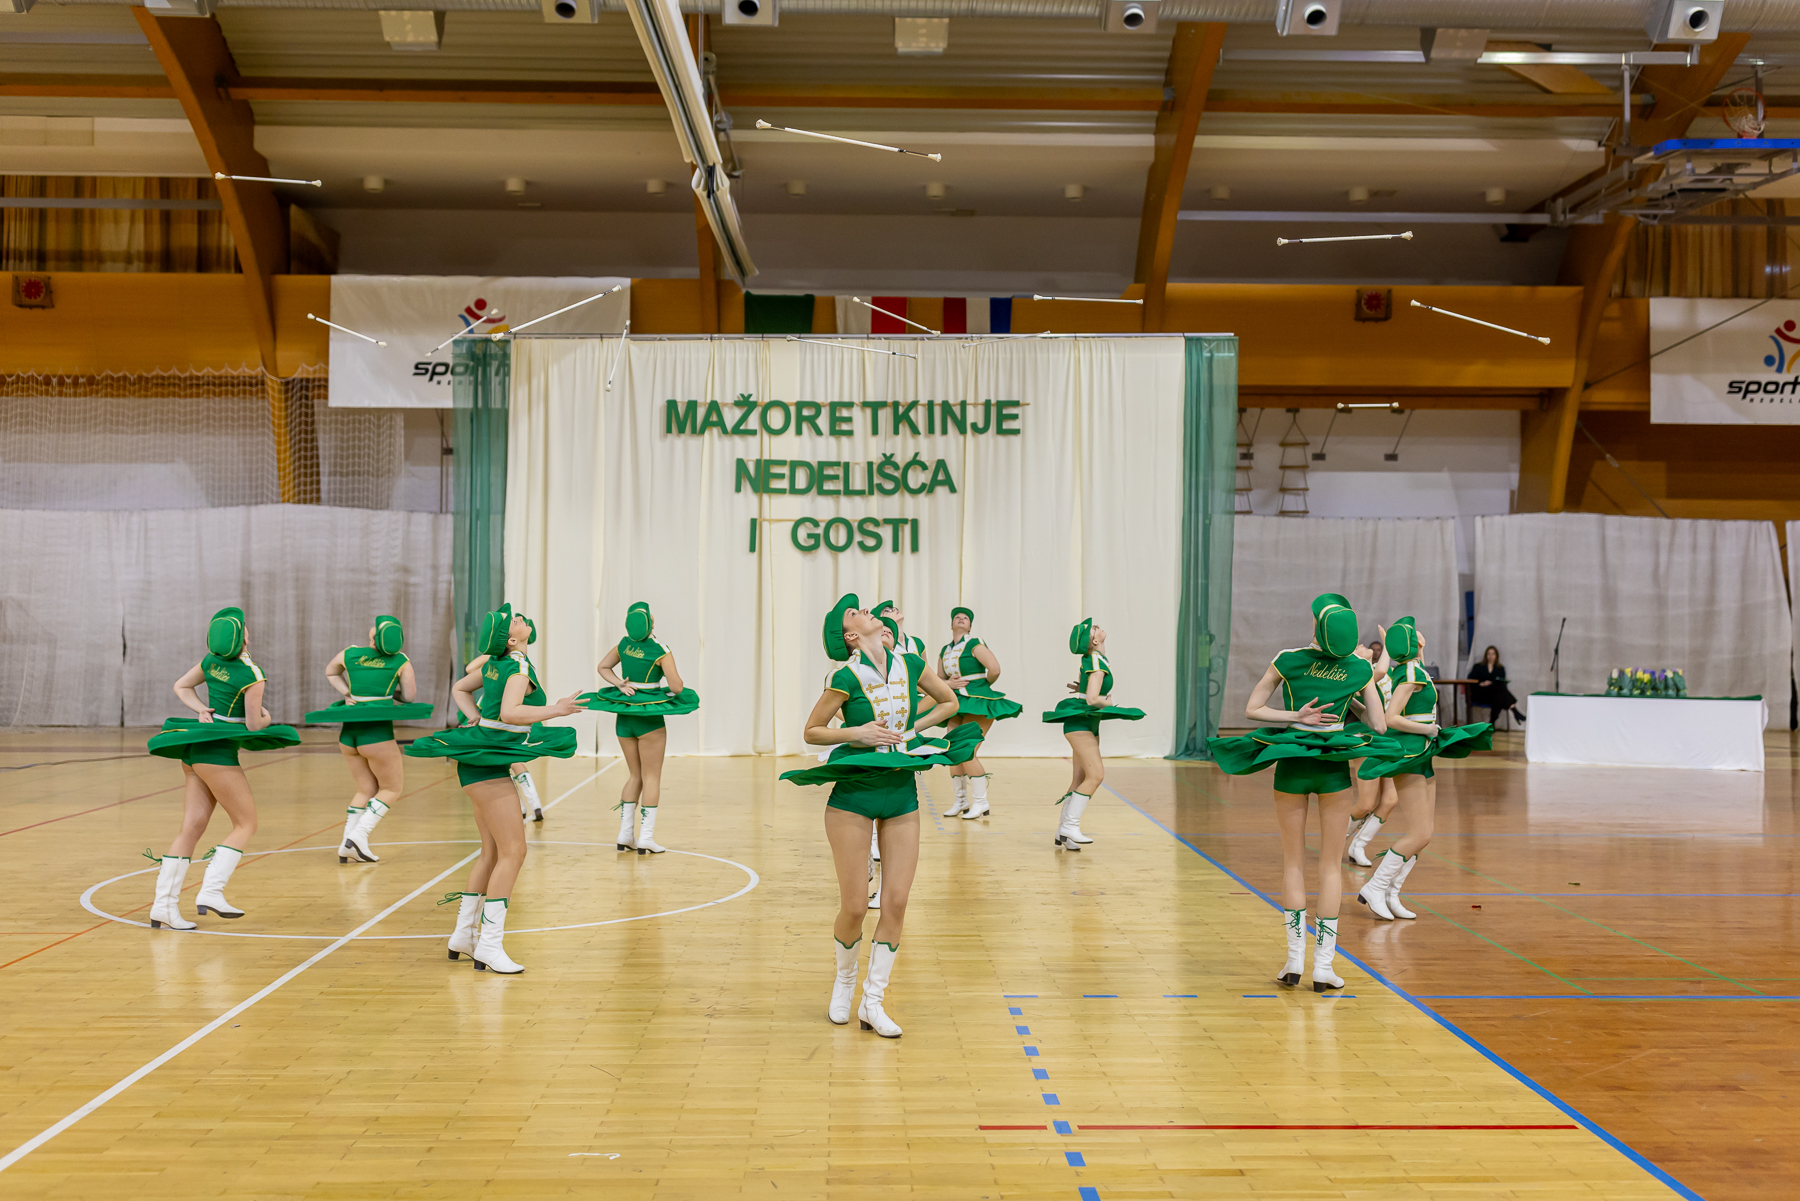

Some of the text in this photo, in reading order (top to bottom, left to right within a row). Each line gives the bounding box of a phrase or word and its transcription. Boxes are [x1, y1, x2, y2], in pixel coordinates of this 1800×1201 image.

[665, 394, 1021, 436] MAŽORETKINJE
[735, 452, 957, 496] NEDELIŠĆA
[749, 517, 919, 553] I GOSTI
